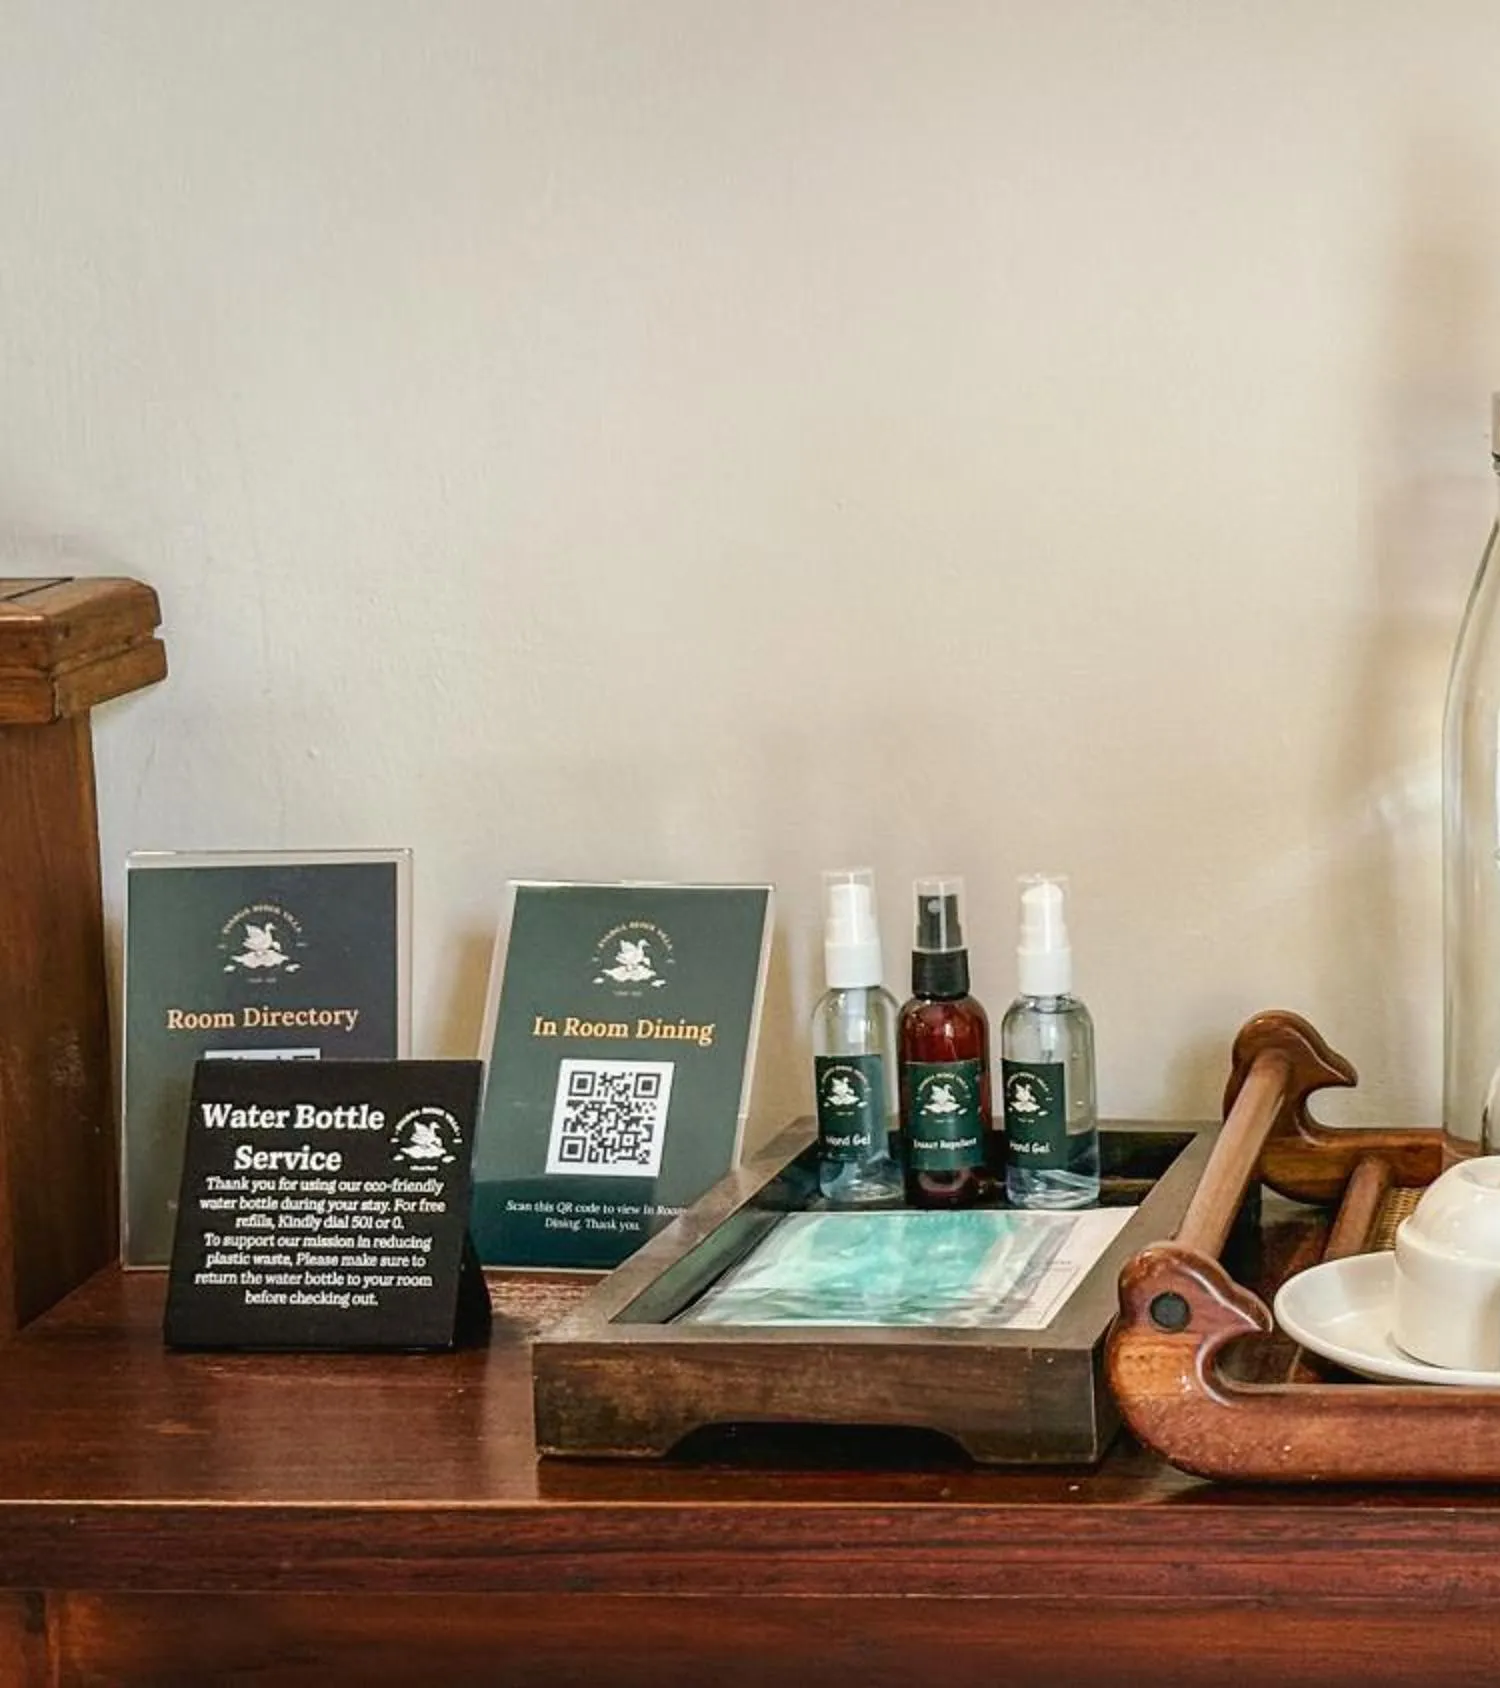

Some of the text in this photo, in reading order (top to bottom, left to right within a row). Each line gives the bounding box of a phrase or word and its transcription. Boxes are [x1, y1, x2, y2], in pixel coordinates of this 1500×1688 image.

[167, 1005, 359, 1031] Room Directory
[533, 1015, 716, 1046] In Room Dining
[201, 1103, 290, 1128] Water
[293, 1103, 385, 1130] Bottle
[852, 1132, 871, 1146] Gel
[233, 1144, 342, 1171] Service
[206, 1176, 444, 1196] Thank you for using our eco-friendly
[199, 1196, 446, 1214] water bottle during your stay. For free
[505, 1200, 532, 1212] Scan
[534, 1201, 554, 1213] this
[556, 1202, 573, 1215] QR
[575, 1202, 600, 1214] code
[603, 1204, 615, 1214] to
[617, 1204, 640, 1215] view
[643, 1204, 655, 1215] In
[235, 1215, 275, 1230] refills,
[278, 1214, 322, 1231] Kindly
[323, 1215, 349, 1229] dial
[352, 1216, 372, 1229] 501
[375, 1219, 390, 1229] or
[584, 1217, 616, 1230] Thank
[204, 1233, 432, 1251] To support our mission in reducing
[206, 1252, 426, 1268] plastic waste, Please make sure to
[194, 1270, 433, 1289] return the water bottle to your room
[245, 1290, 379, 1308] before checking out.
